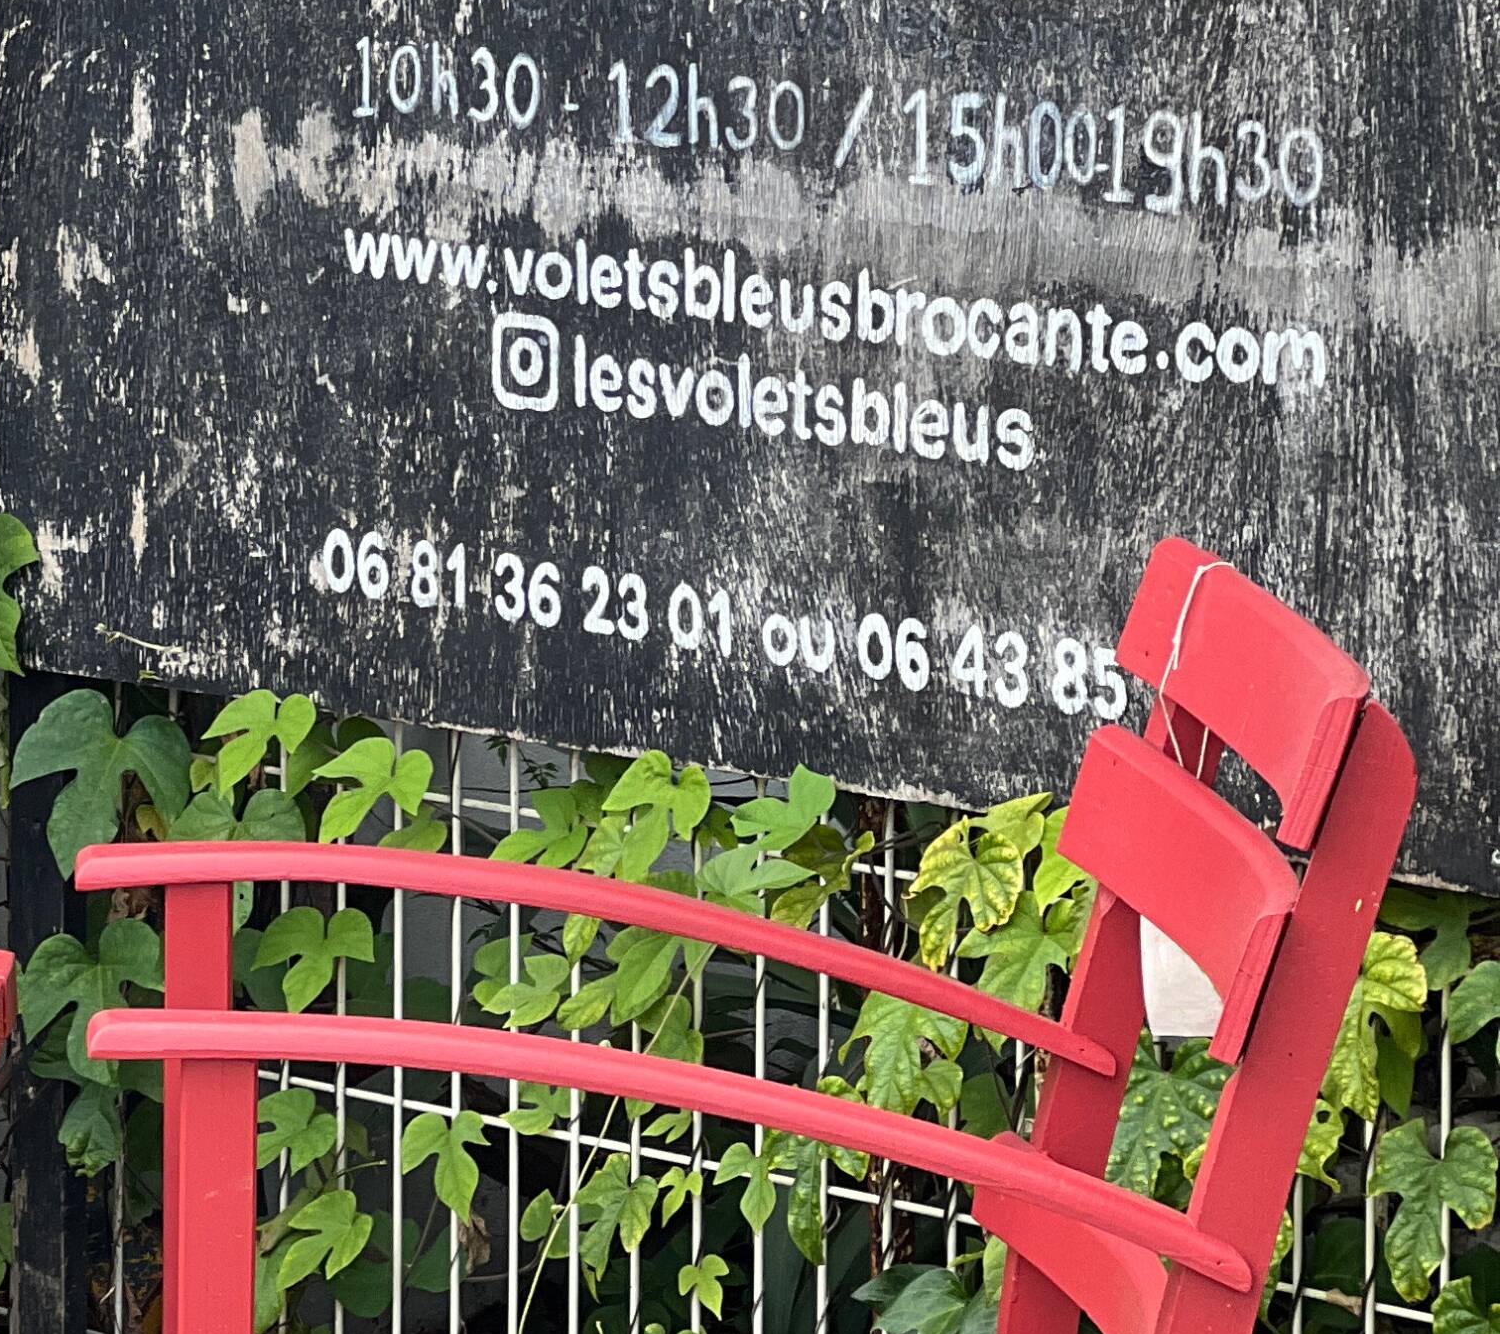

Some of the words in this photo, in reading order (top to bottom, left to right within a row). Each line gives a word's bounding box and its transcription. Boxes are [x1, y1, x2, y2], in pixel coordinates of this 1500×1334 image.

[352, 36, 540, 130] 10h30
[607, 59, 805, 152] 12h30
[834, 86, 873, 168] /
[344, 228, 1325, 388] www.voletsbleusbrocante.com
[573, 334, 1036, 471] lesvoletsbleus
[323, 528, 389, 599] 06
[411, 540, 465, 608] 81
[495, 553, 561, 628] 36
[582, 565, 649, 641] 23
[668, 581, 731, 657] 01
[762, 613, 835, 673] ou
[857, 613, 930, 692] 06
[952, 624, 1029, 708] 43
[1052, 638, 1127, 720] 85
